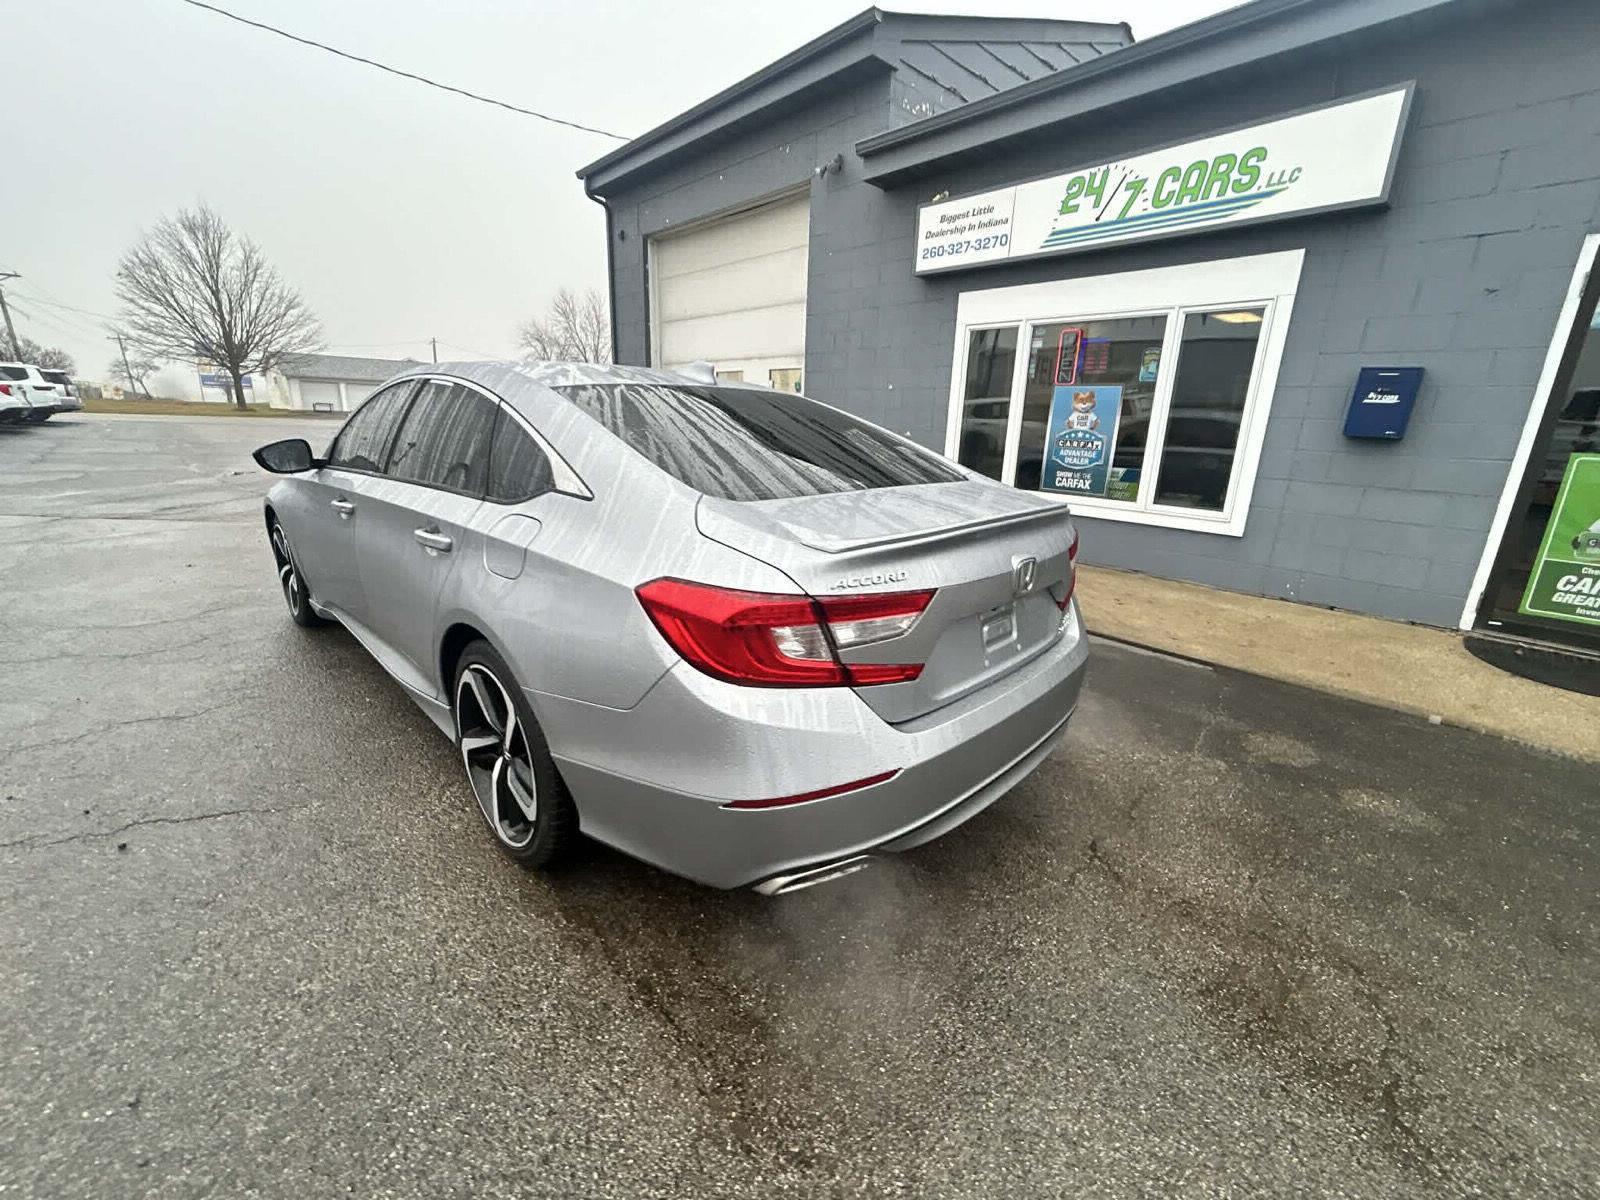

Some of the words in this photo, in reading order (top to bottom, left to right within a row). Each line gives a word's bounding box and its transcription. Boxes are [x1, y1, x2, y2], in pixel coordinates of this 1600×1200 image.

[1265, 166, 1302, 189] LLC
[939, 210, 970, 224] Biggest
[971, 205, 995, 217] Little
[925, 225, 967, 240] Dealership
[967, 223, 976, 232] In
[977, 217, 1009, 230] Indiana
[922, 233, 1009, 260] 260-327-3270
[1059, 448, 1097, 459] ADVANTAGE
[1064, 456, 1090, 465] DEALER
[1055, 477, 1092, 490] CARFAX
[1056, 470, 1073, 478] SHOW
[830, 569, 907, 591] ACCORD
